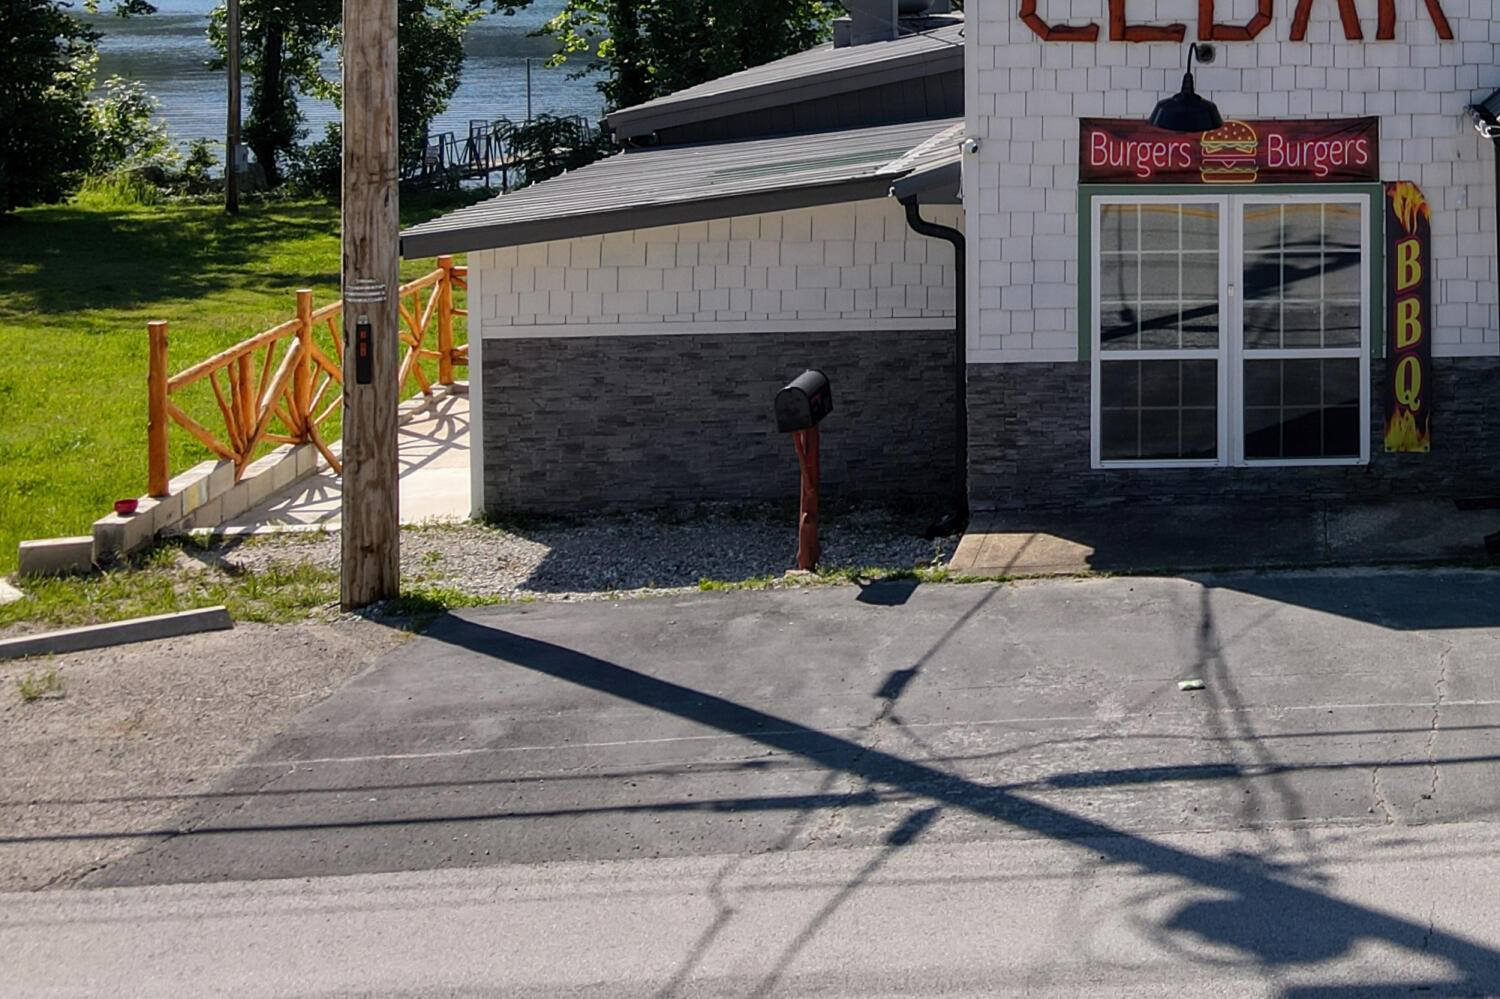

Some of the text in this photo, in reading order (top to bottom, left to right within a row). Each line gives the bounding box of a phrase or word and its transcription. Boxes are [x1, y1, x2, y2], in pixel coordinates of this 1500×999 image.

[1090, 131, 1368, 178] Burgers Burgers
[1394, 237, 1424, 412] BBQ
